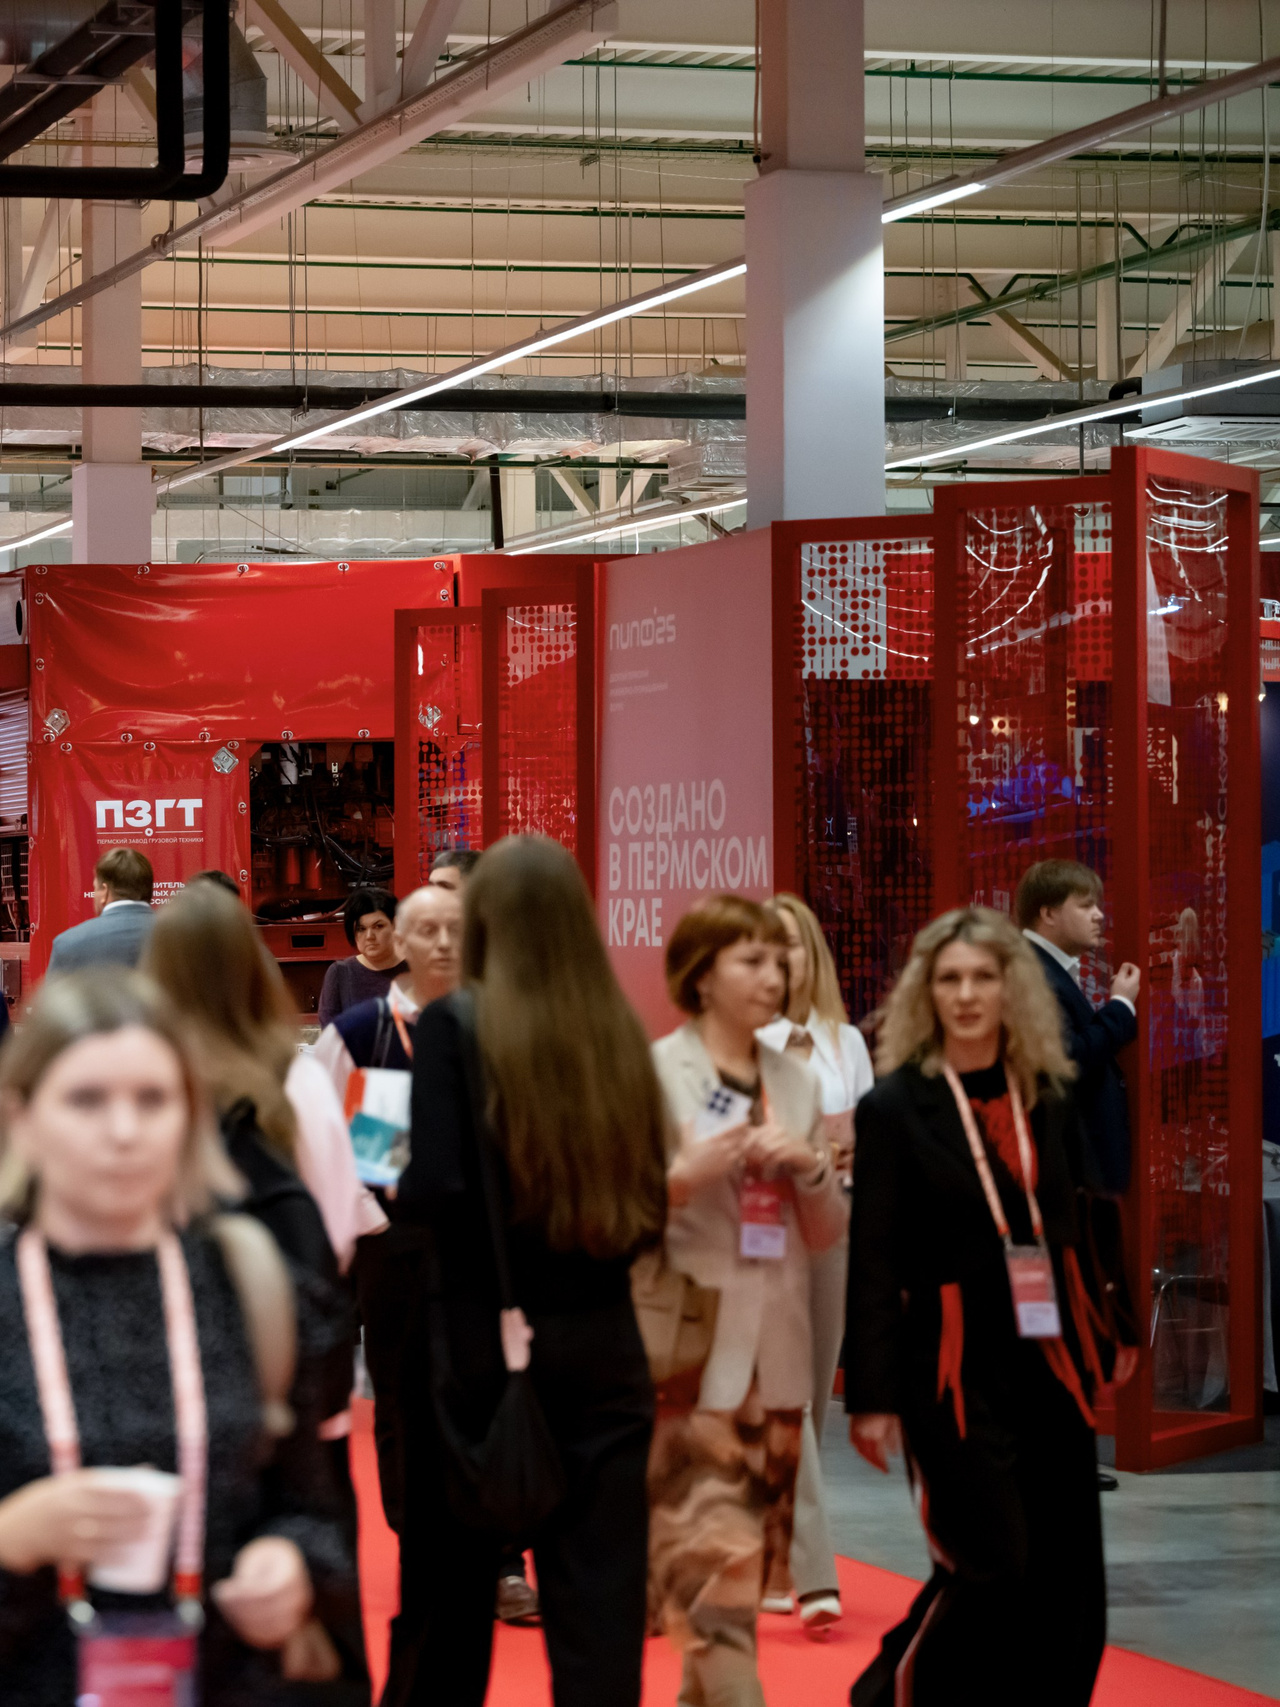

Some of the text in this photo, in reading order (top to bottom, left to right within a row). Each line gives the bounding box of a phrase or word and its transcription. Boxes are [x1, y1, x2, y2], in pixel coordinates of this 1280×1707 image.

[95, 798, 203, 829] ПЗГТ
[608, 778, 726, 842] СОЗДАНО
[148, 836, 178, 844] ГРУЗОВОЙ
[608, 835, 769, 891] В ПЕРМСКОМ
[608, 897, 663, 947] КРАЕ
